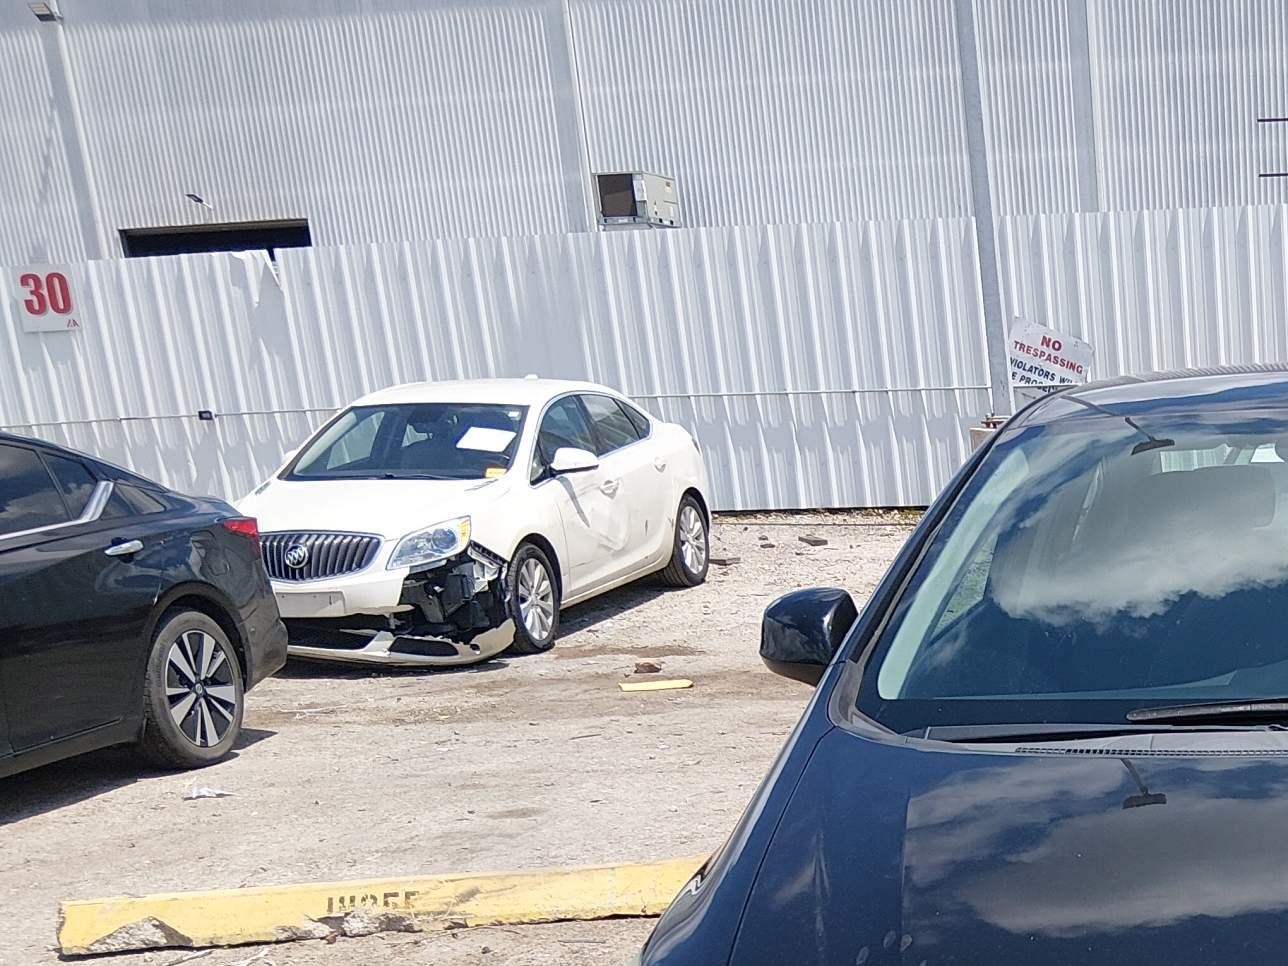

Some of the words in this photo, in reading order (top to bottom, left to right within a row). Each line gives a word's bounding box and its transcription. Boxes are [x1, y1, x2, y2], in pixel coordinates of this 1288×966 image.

[20, 272, 72, 316] 30
[1014, 340, 1083, 374] TRESPASSING
[1041, 335, 1062, 352] NO
[1010, 357, 1056, 381] VIOLATORS
